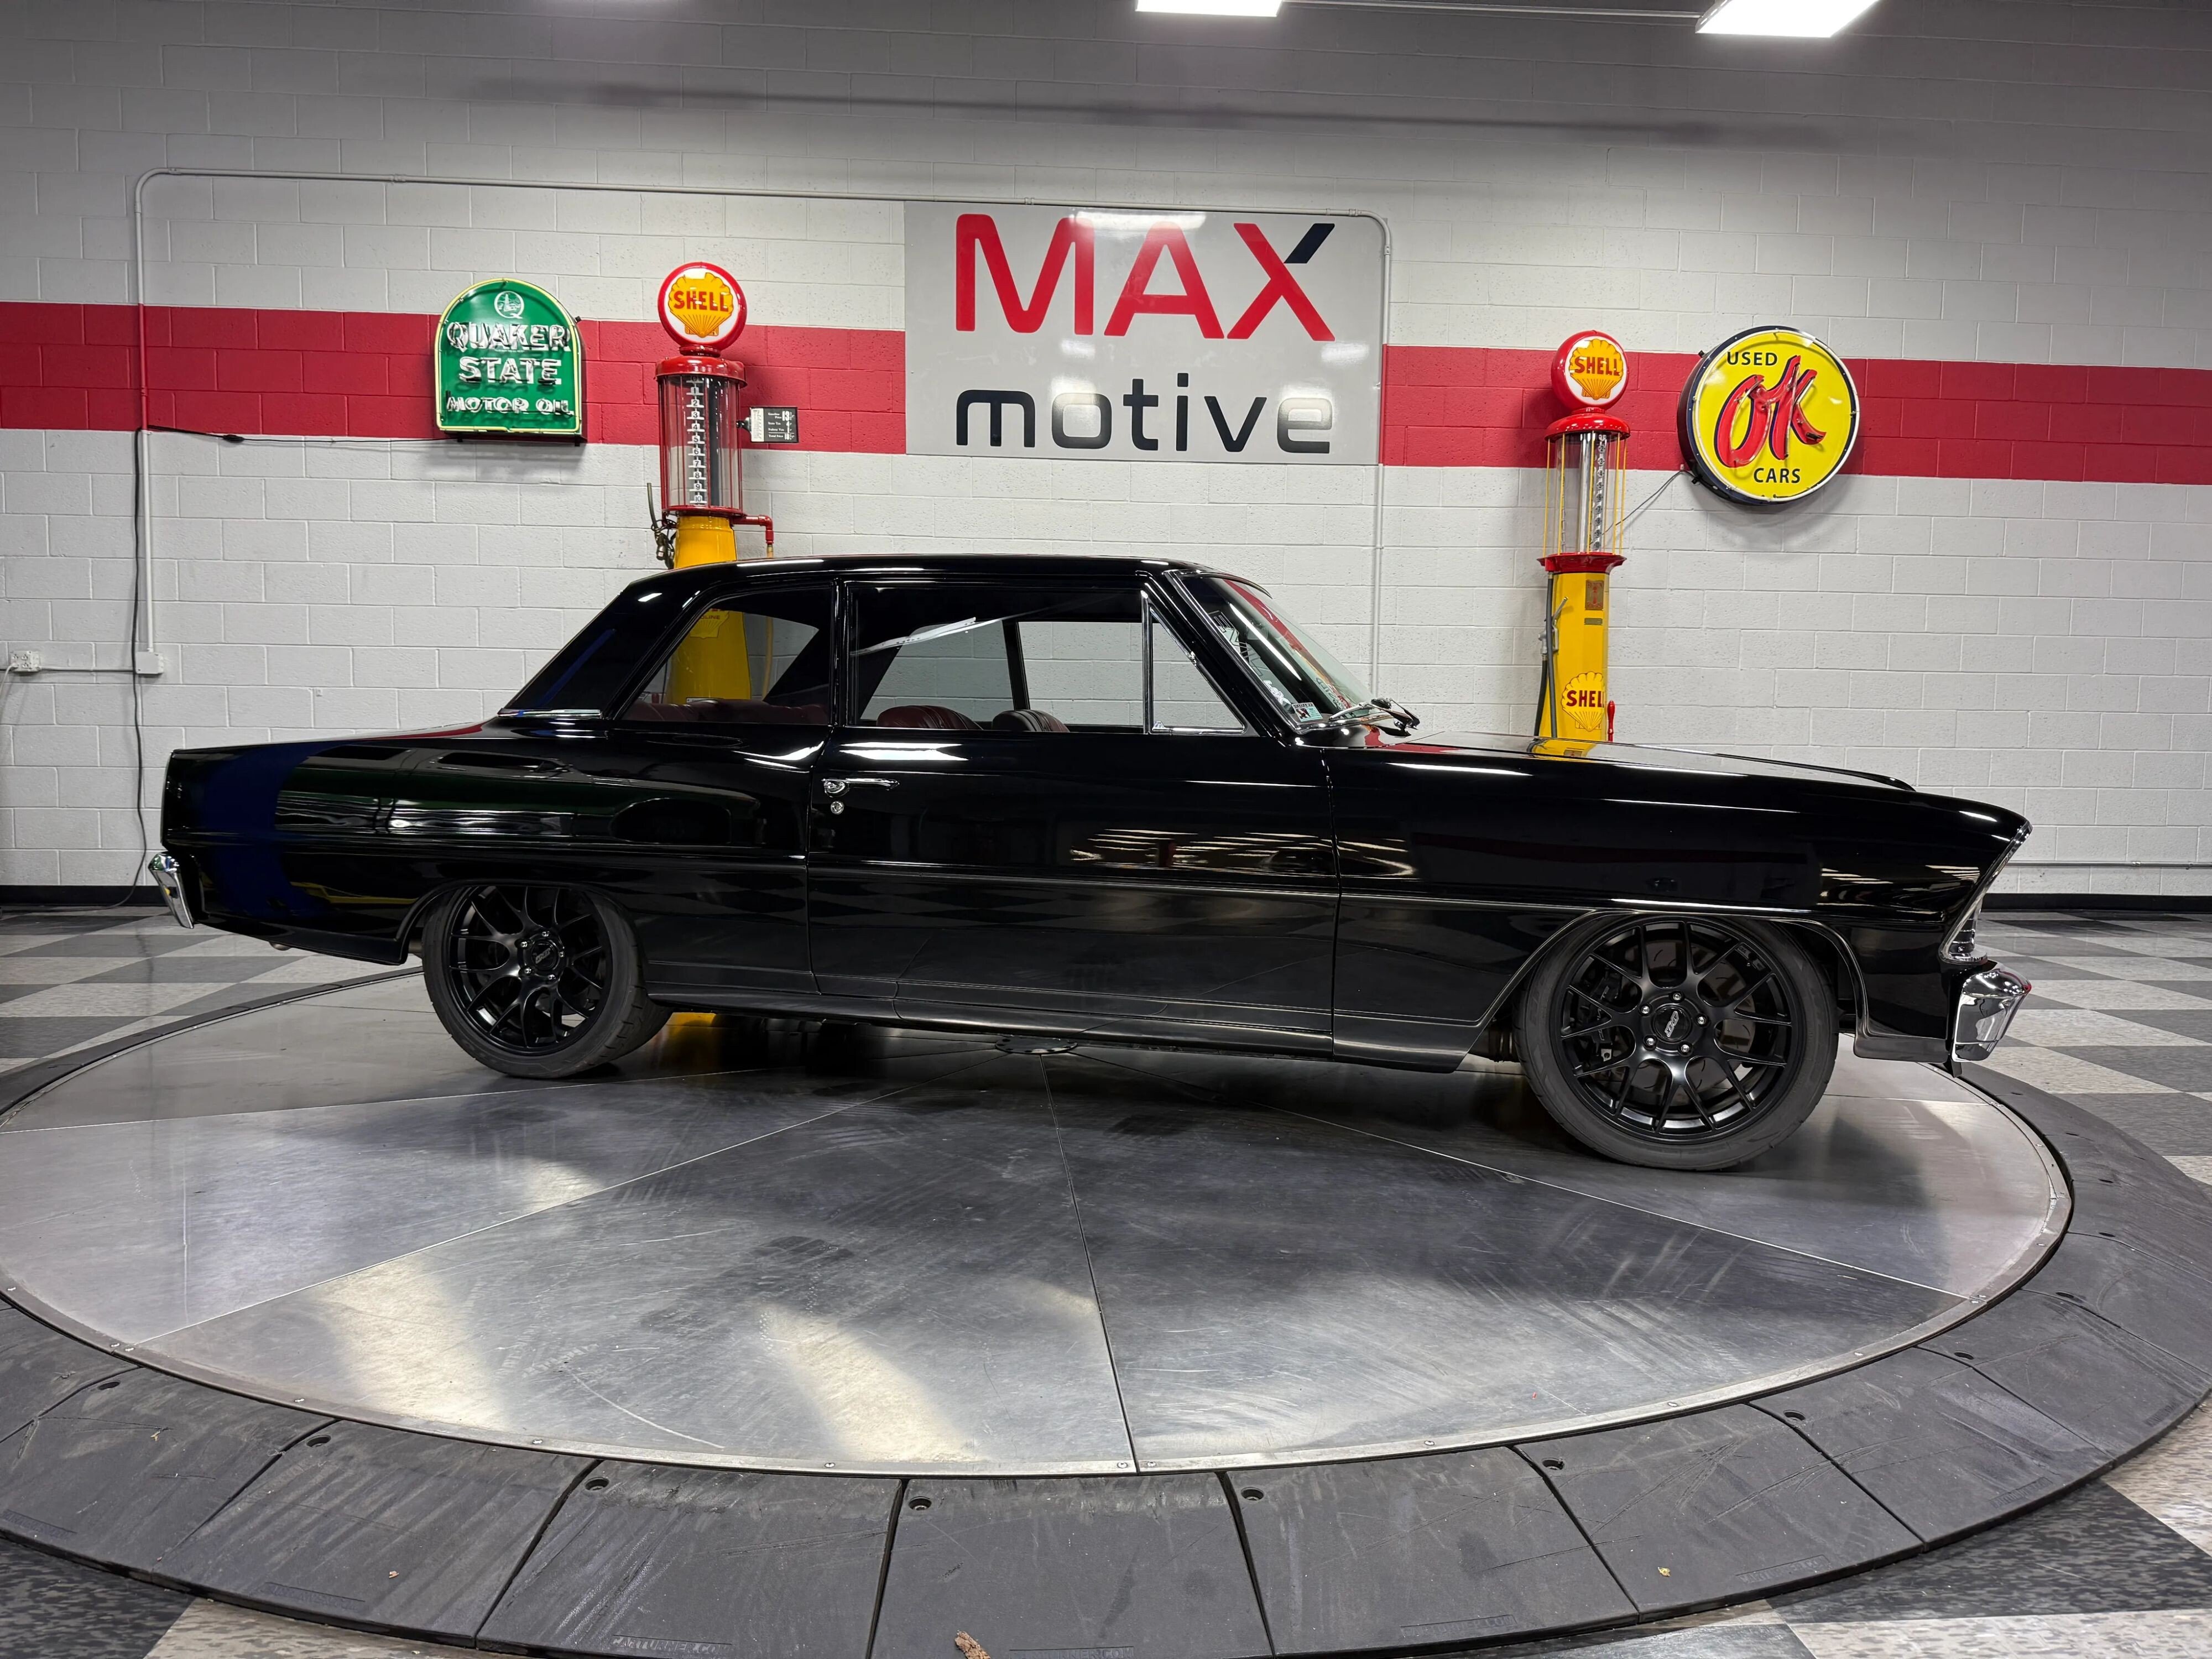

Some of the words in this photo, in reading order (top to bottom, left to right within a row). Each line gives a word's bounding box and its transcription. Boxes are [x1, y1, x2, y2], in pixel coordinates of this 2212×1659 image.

[956, 214, 1335, 341] MAX
[674, 290, 728, 312] SHELL
[447, 322, 571, 352] QUAKER
[459, 356, 562, 385] STATE
[1574, 356, 1620, 376] SHELL
[1728, 352, 1777, 366] USED
[447, 397, 529, 414] MOTOR
[536, 398, 574, 415] OIL
[956, 373, 1333, 453] motive
[1713, 355, 1827, 468] OK
[1754, 468, 1801, 483] CARS
